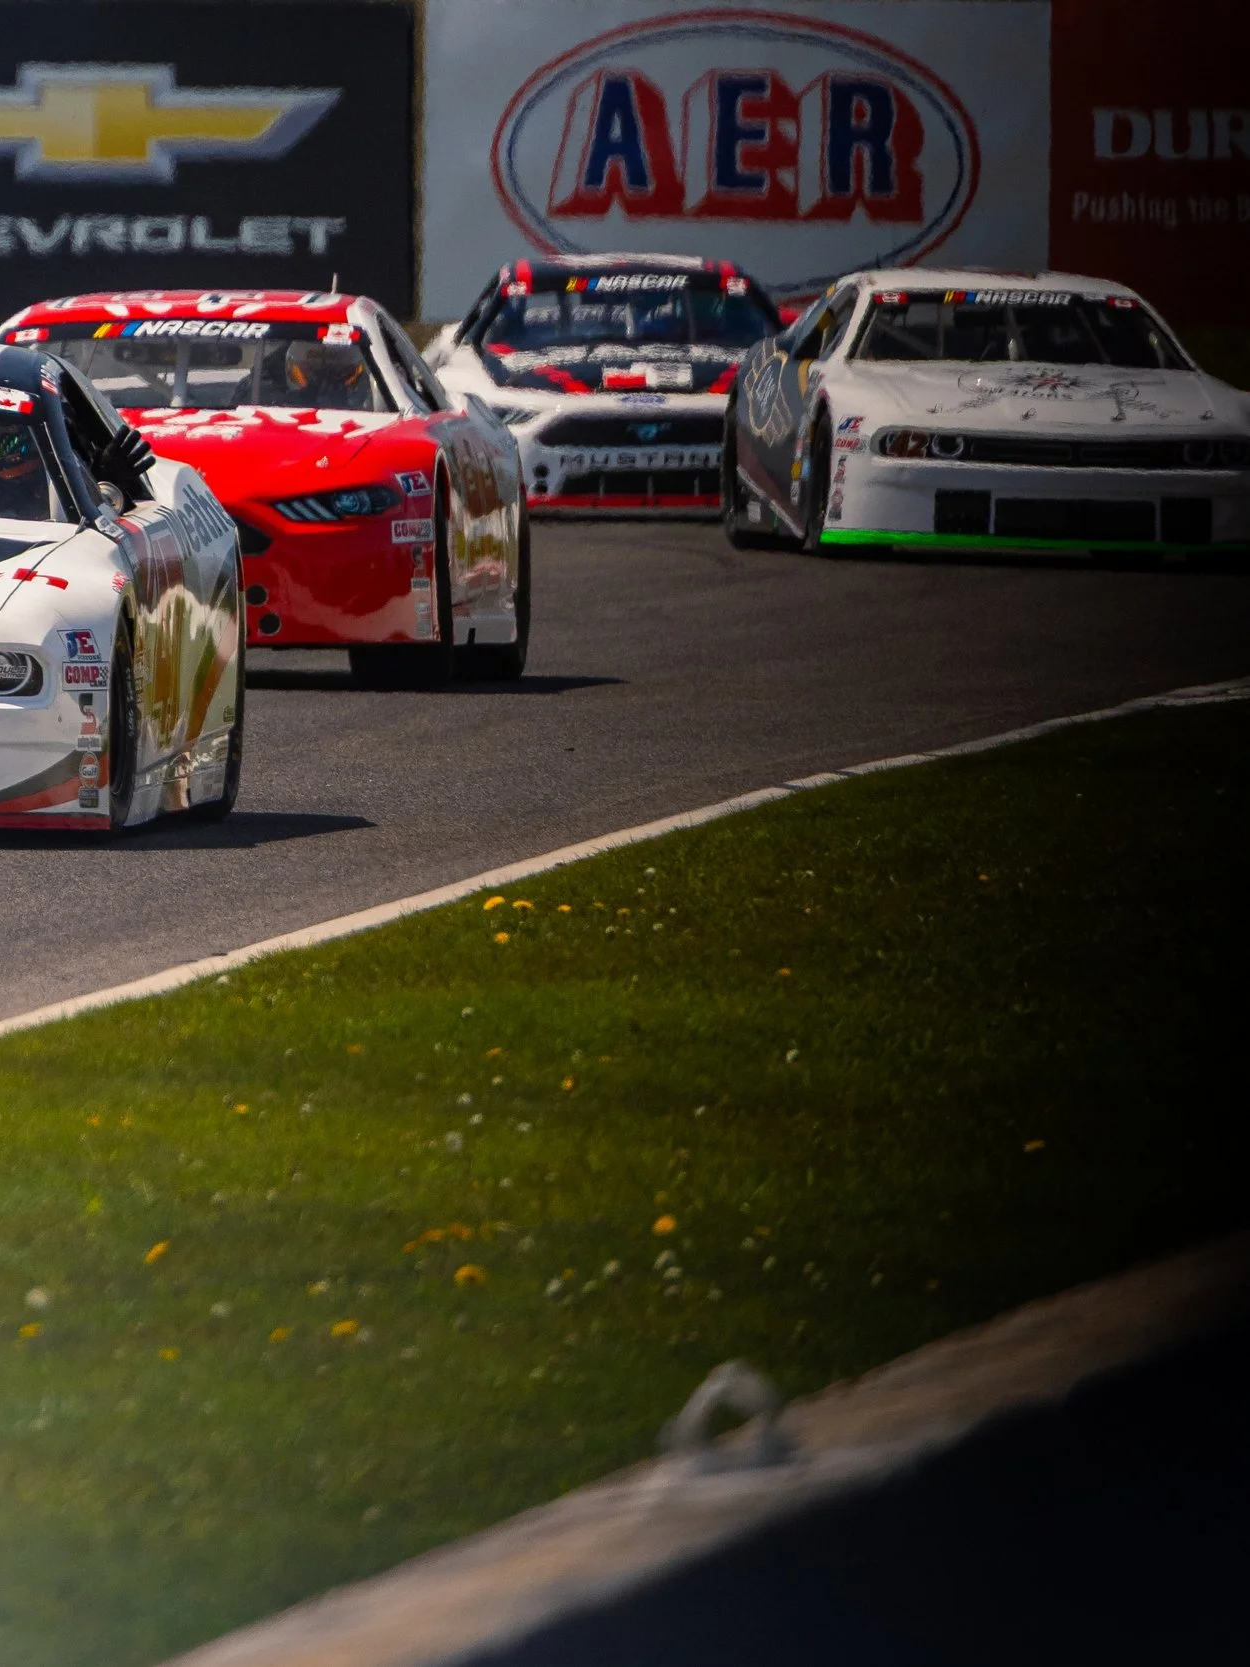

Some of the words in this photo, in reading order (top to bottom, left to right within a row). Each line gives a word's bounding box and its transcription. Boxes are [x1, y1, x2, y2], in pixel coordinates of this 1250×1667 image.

[565, 68, 915, 212] AER
[1071, 190, 1178, 231] Pushing
[1187, 192, 1230, 224] the
[595, 275, 689, 292] NASCAR
[974, 291, 1072, 306] NASCAR
[133, 320, 270, 338] NASCAR
[560, 452, 724, 470] MUSTAN
[65, 631, 95, 659] JE
[65, 665, 100, 684] COMP
[82, 766, 97, 777] Gulf
